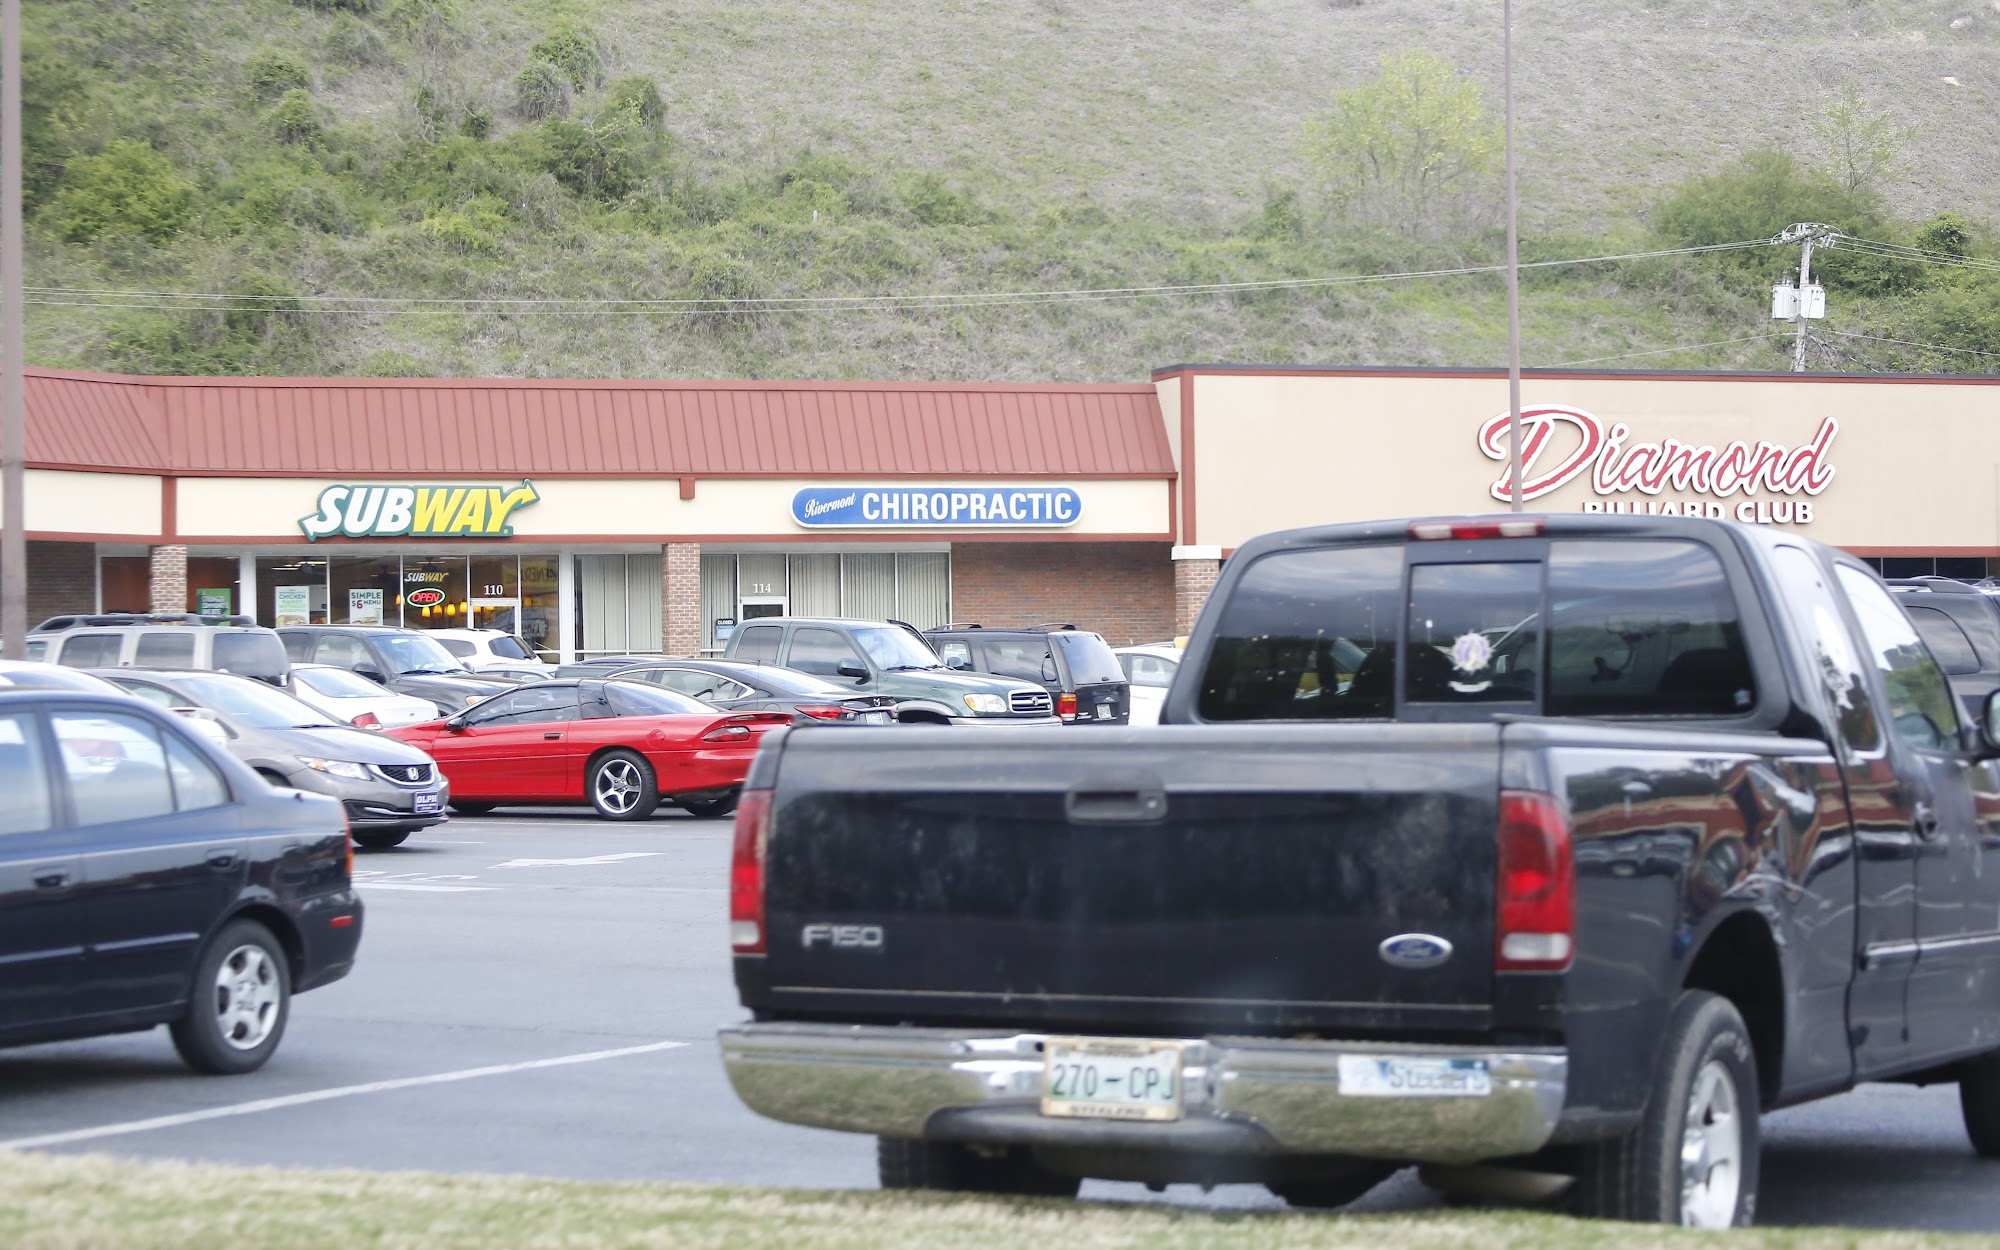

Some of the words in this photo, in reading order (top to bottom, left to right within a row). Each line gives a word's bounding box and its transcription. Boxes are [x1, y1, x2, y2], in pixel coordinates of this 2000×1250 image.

[1479, 403, 1840, 501] Diamond
[302, 484, 537, 537] SUBWAY
[804, 492, 857, 518] Rivermont
[862, 492, 1072, 520] CHIROPRACTIC
[1736, 501, 1815, 524] CLUB
[404, 572, 449, 582] SUBWAY
[483, 584, 504, 595] 110
[753, 583, 772, 594] 114
[351, 592, 382, 600] SIMPLE
[411, 592, 441, 603] OPEN
[351, 600, 363, 609] $6
